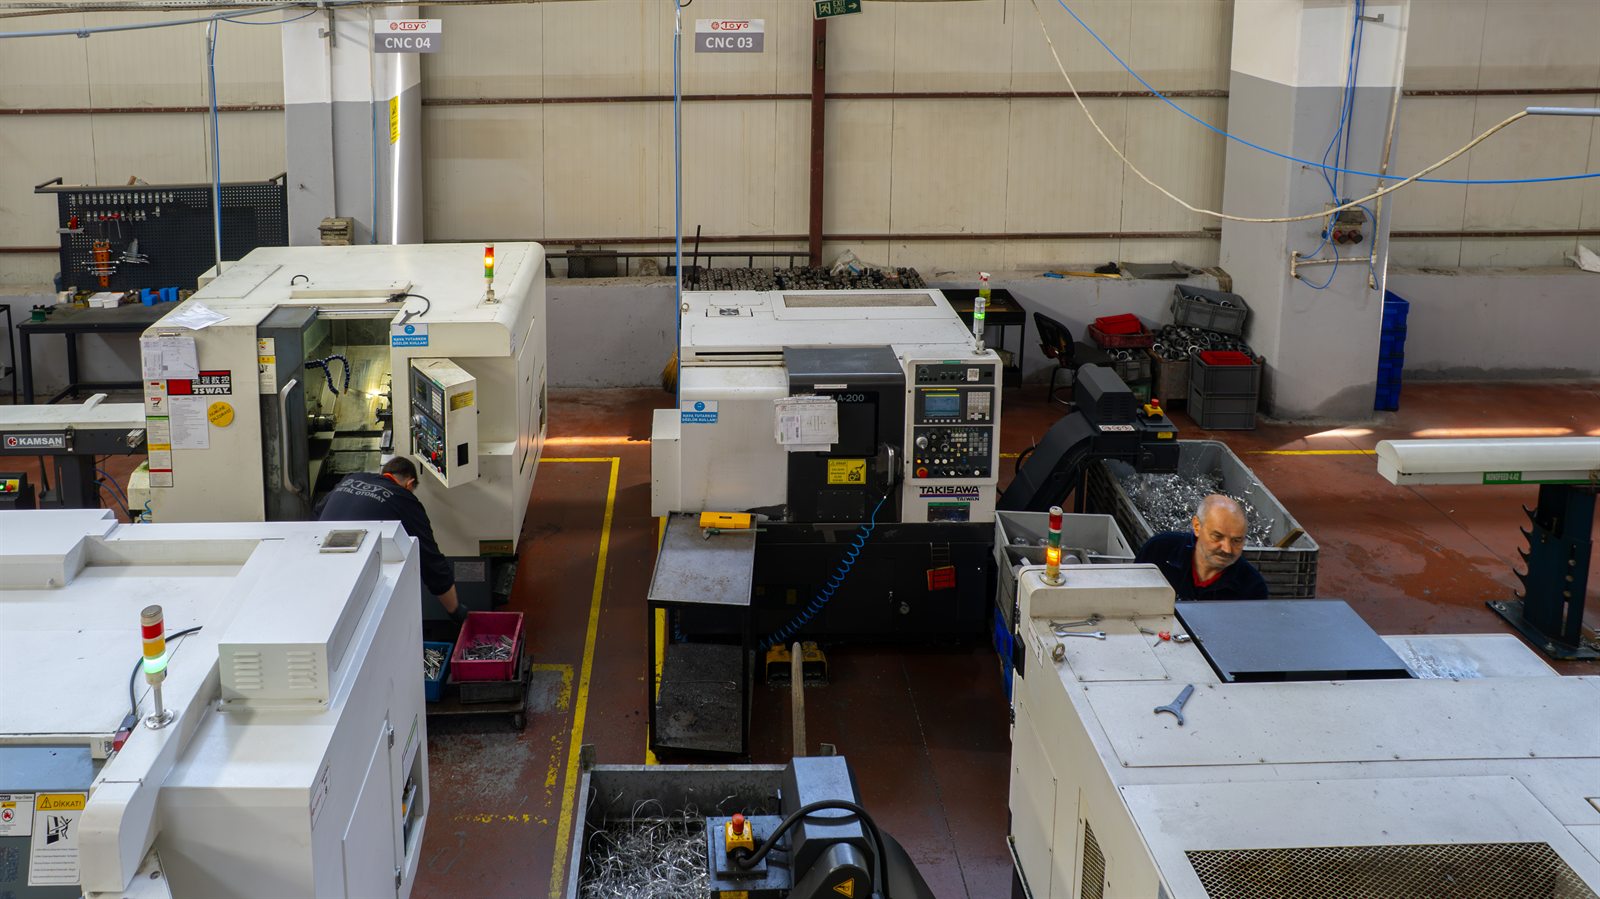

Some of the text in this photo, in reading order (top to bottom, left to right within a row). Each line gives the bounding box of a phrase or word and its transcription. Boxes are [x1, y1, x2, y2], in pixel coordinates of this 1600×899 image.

[399, 22, 427, 30] Toyo
[721, 21, 749, 30] Toyo
[385, 37, 431, 49] CNC 04
[705, 37, 753, 48] CNC 03
[19, 437, 62, 445] KAMSAN
[920, 486, 979, 494] TAKISAWA
[355, 490, 386, 503] OTOMAT
[53, 800, 82, 808] DİKKAT!
